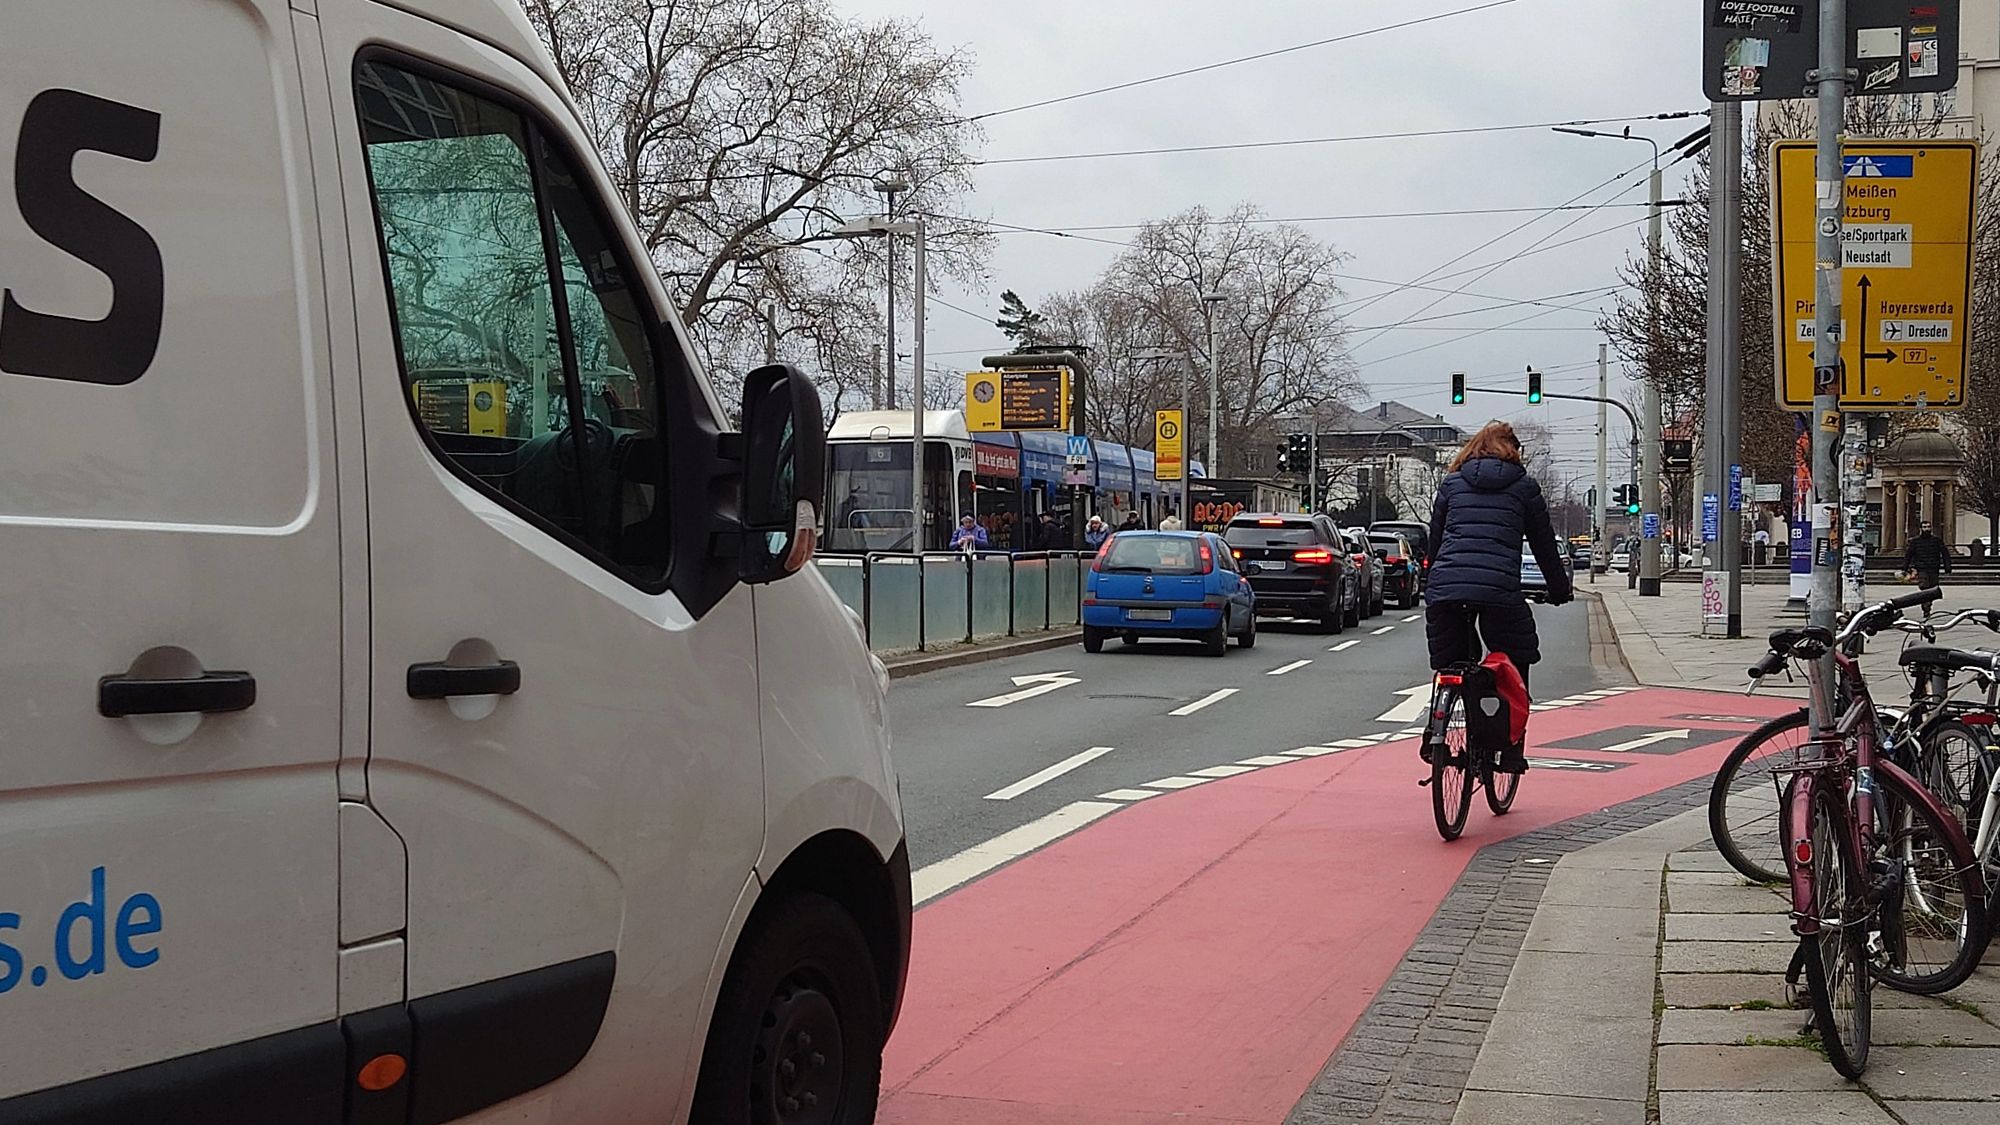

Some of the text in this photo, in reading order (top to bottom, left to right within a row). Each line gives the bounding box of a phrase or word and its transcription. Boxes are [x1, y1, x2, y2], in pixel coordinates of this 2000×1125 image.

[1721, 1, 1796, 15] LOVE FOOTBALL
[1724, 14, 1752, 24] HATE
[1924, 40, 1937, 51] CE
[1846, 184, 1897, 198] Meißen
[1843, 205, 1891, 221] tzburg
[0, 88, 164, 386] S
[1841, 228, 1908, 244] se/Sportpark
[1846, 250, 1892, 264] Neustadt
[1796, 300, 1815, 314] Pir
[1880, 301, 1954, 317] Hoyerswerda
[1908, 324, 1948, 338] Dresden
[1908, 350, 1921, 361] 97
[1068, 438, 1086, 455] W
[0, 866, 163, 994] s.de
